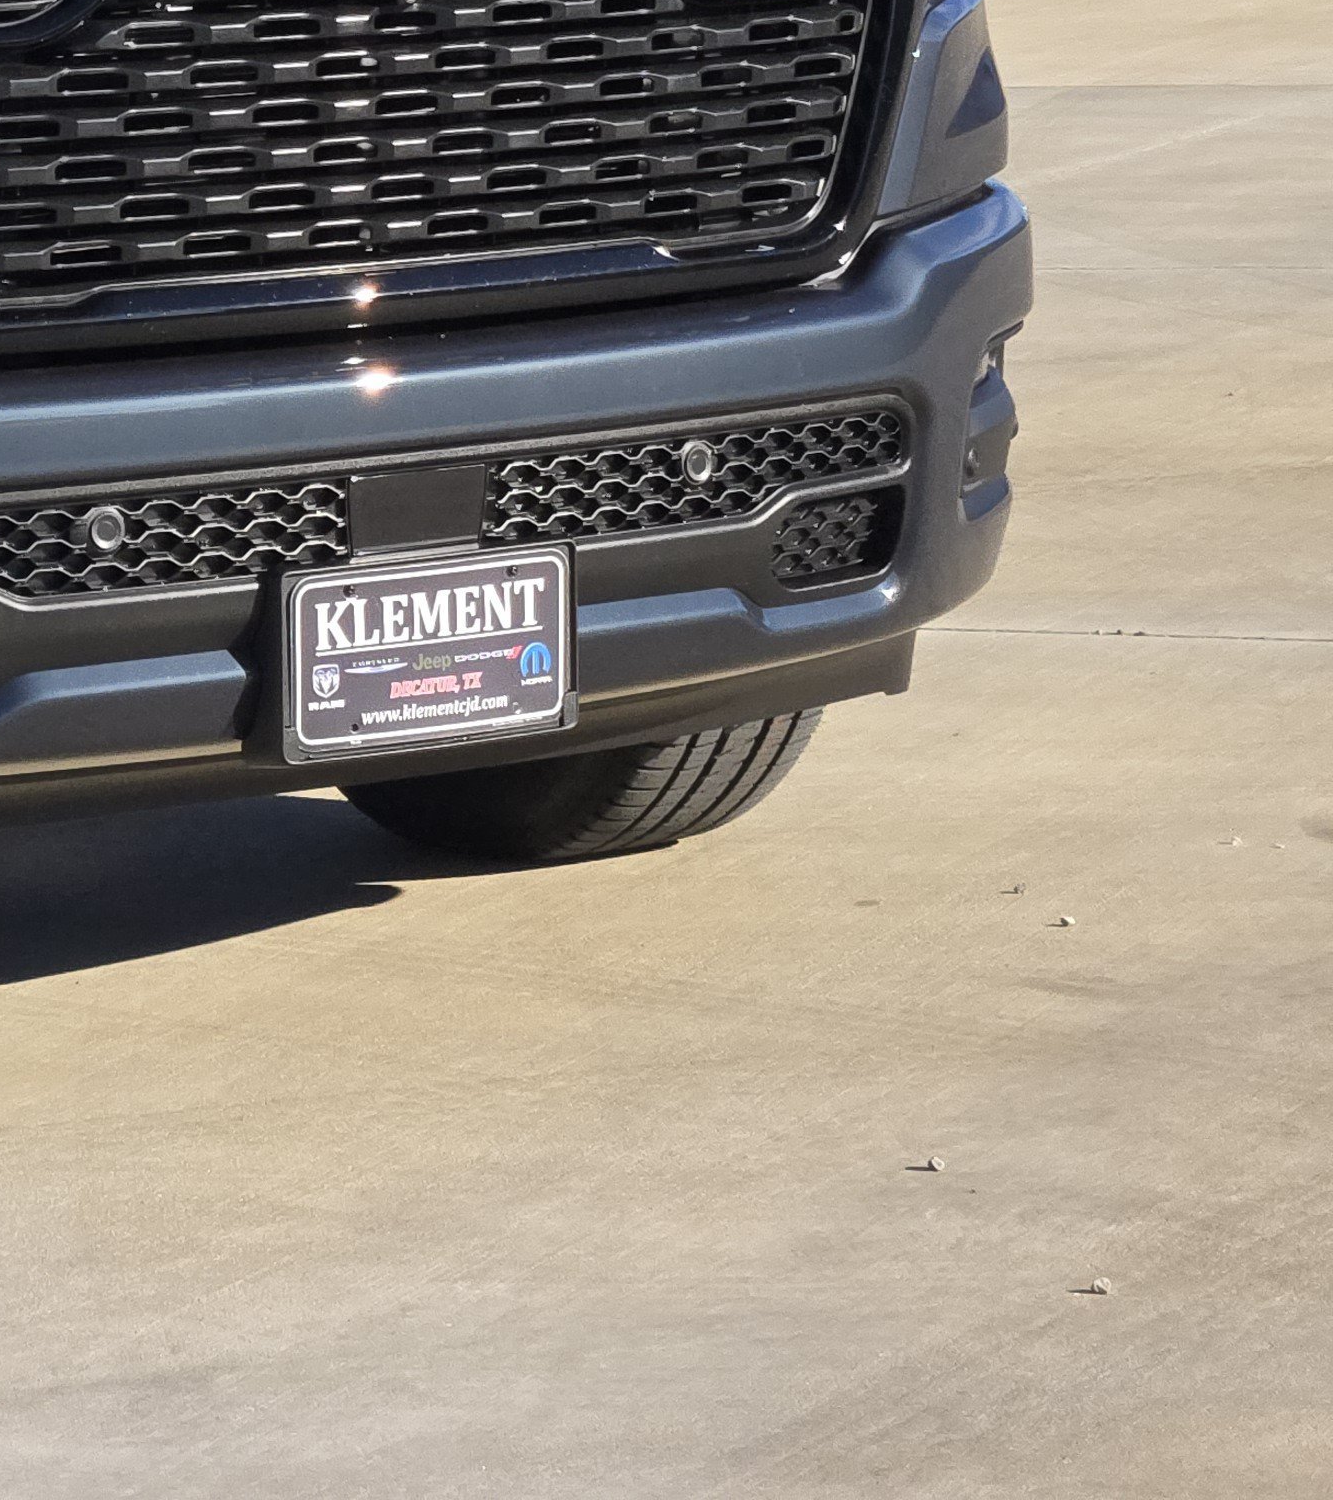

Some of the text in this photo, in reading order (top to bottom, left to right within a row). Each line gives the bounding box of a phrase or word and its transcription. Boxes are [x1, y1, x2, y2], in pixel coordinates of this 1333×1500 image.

[314, 577, 545, 651] KLEMENT
[412, 652, 451, 672] Jeep
[462, 671, 483, 690] TX
